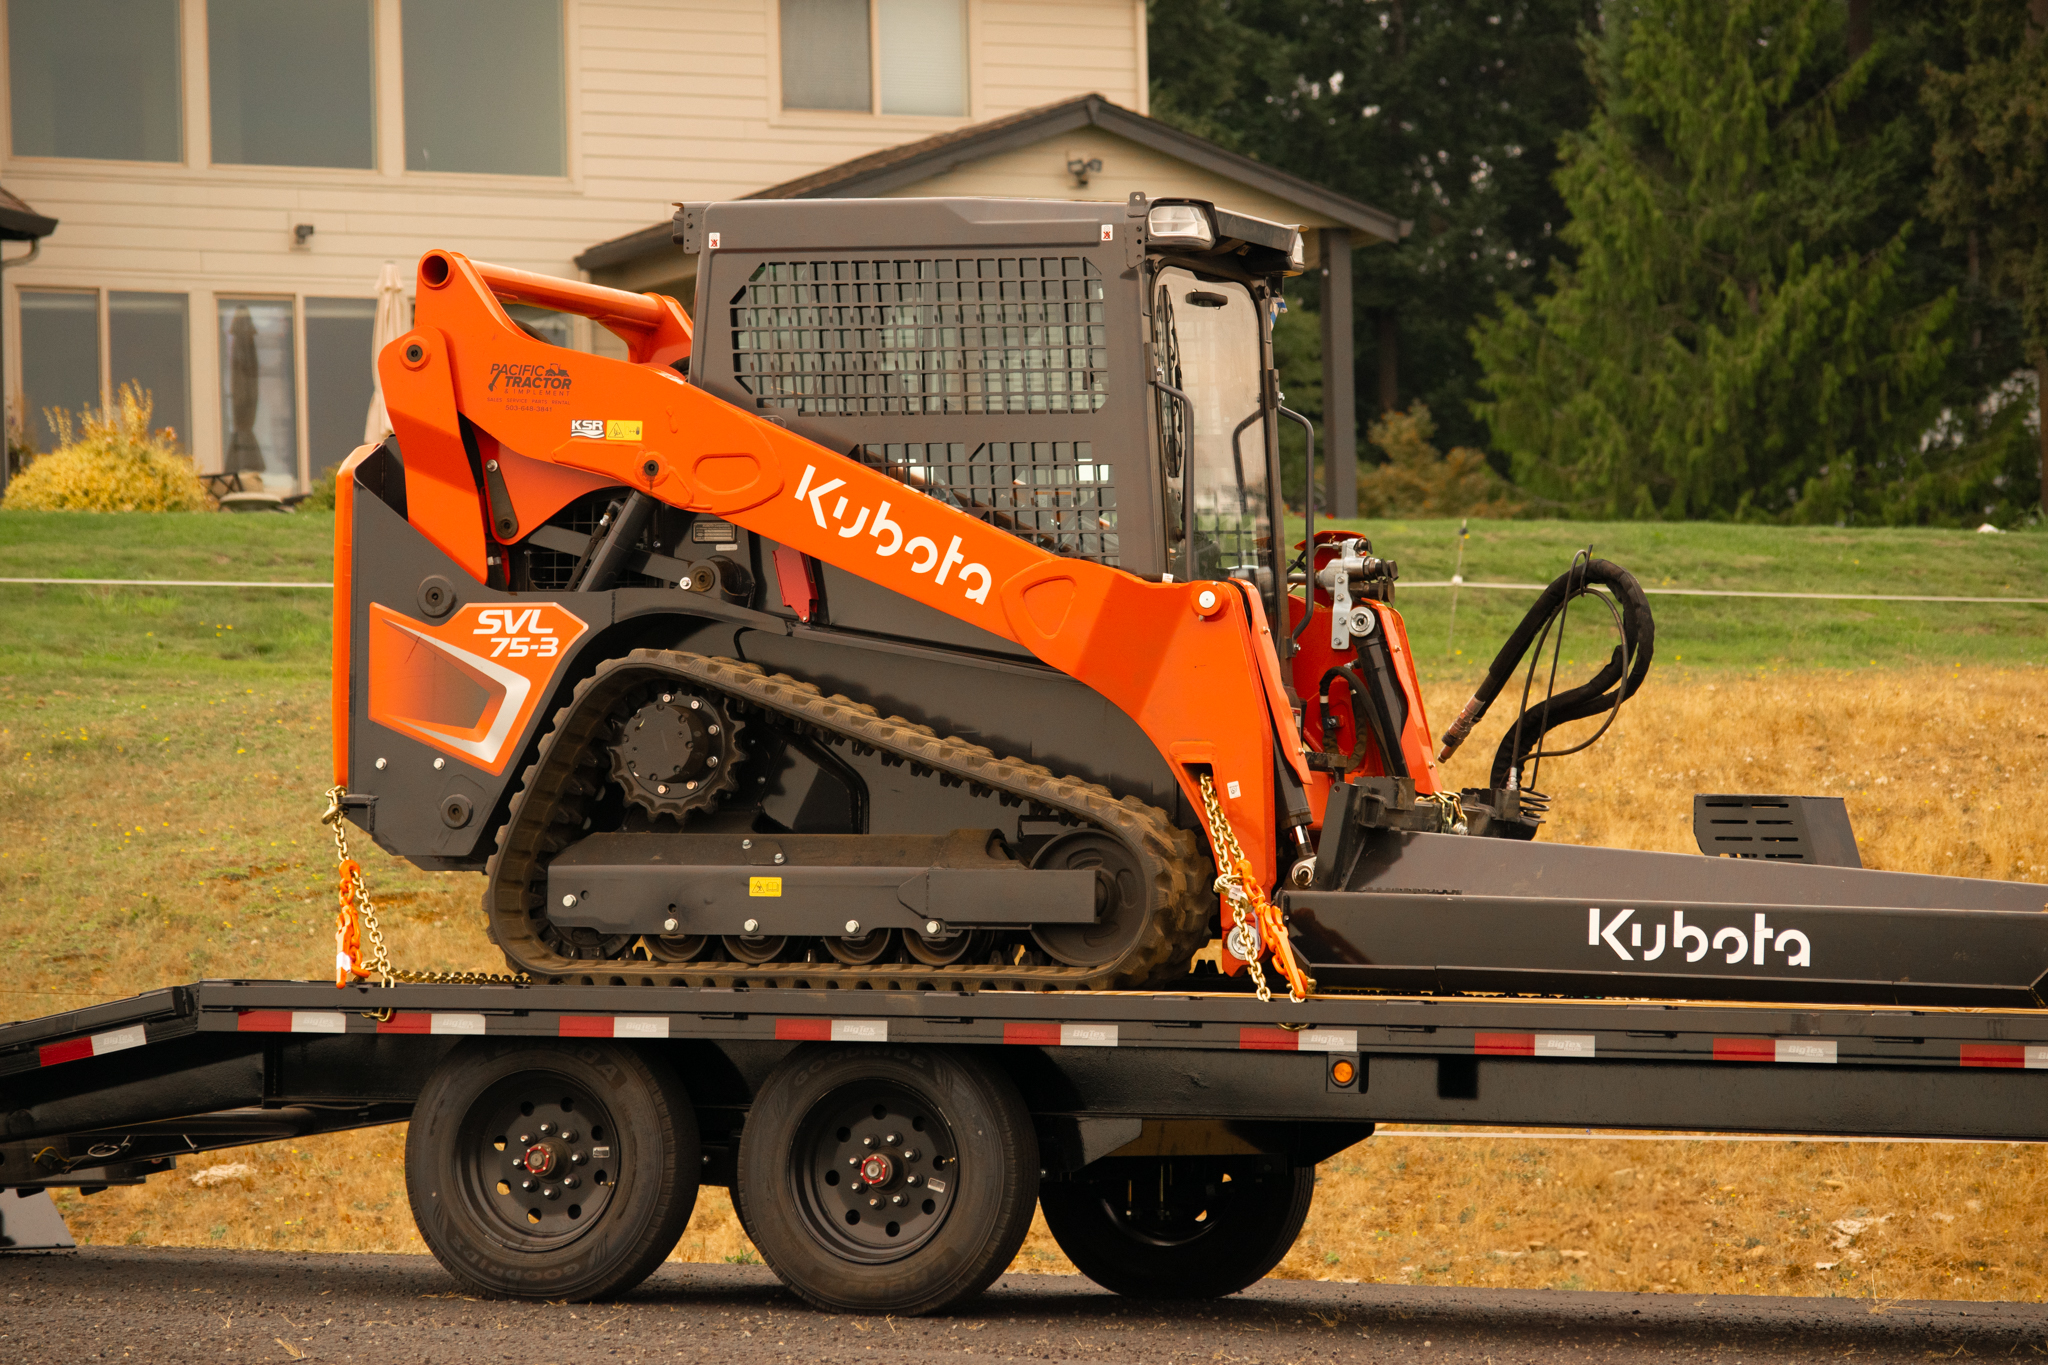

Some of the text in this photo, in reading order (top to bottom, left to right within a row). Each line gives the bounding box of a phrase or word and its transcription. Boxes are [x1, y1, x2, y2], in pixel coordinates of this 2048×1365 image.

[490, 363, 545, 377] PACIFIC
[505, 375, 572, 390] TRACTOR
[513, 389, 570, 397] IMPLEMENT
[505, 404, 552, 412] 503-648-3841
[571, 419, 604, 431] KSR
[794, 464, 992, 606] Kubota
[472, 609, 554, 635] SVL
[489, 637, 559, 658] 75-3
[1588, 907, 1811, 967] Kubota
[843, 1025, 875, 1035] BigTex
[1073, 1029, 1106, 1039] BigTex
[1311, 1034, 1345, 1044] BigTex
[1547, 1040, 1582, 1049] BigTex
[1788, 1045, 1824, 1055] BigTex
